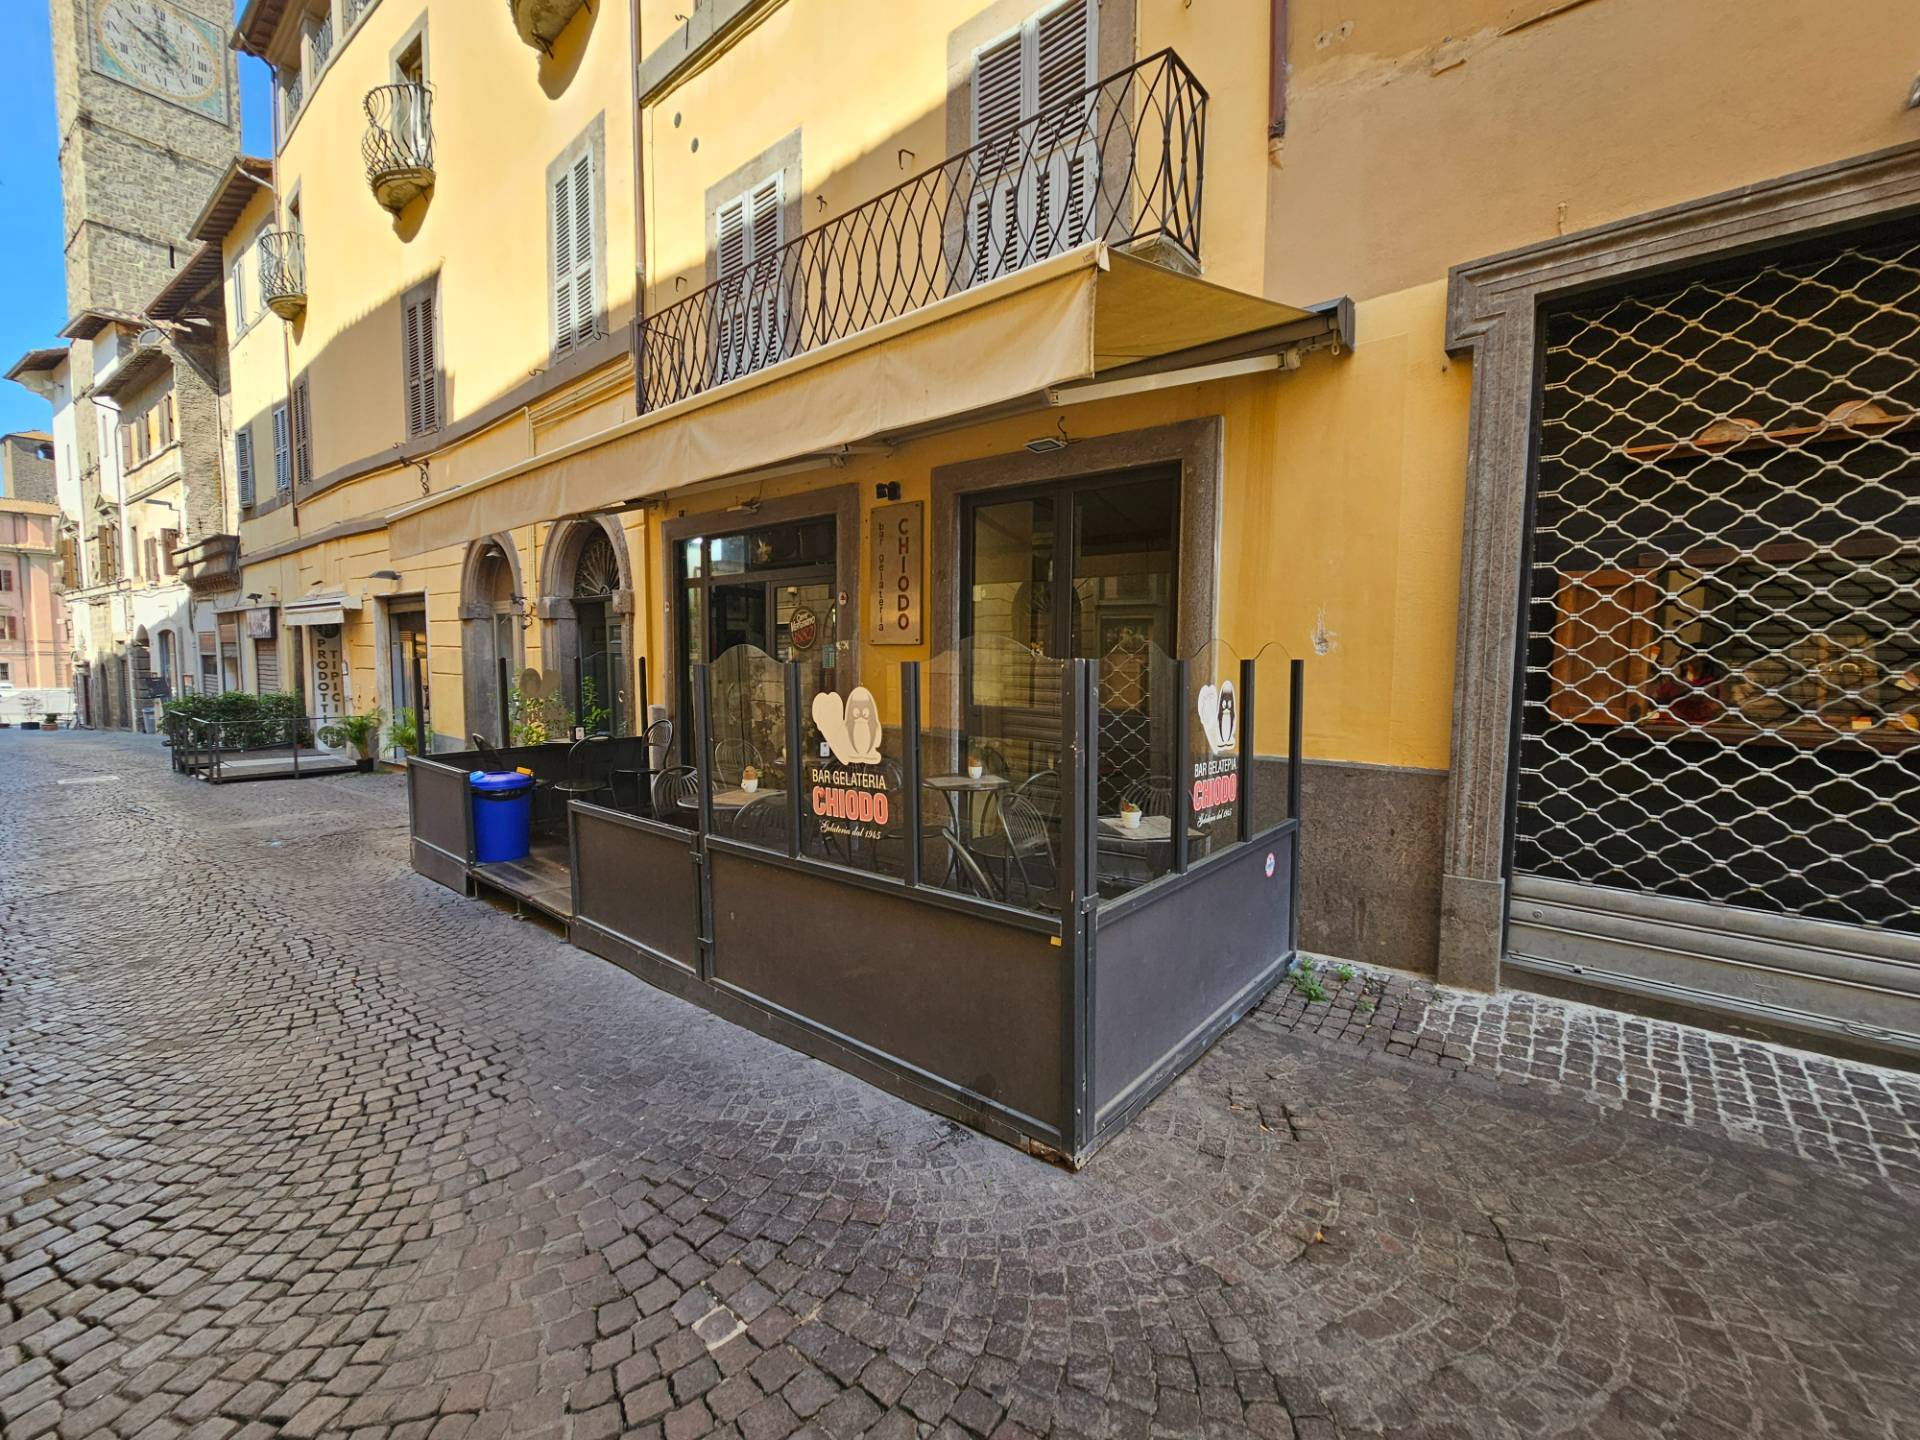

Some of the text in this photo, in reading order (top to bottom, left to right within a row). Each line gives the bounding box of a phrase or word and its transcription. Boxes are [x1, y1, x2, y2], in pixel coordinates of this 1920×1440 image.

[897, 518, 910, 630] CHIODO
[317, 639, 330, 724] PRODOTTI
[329, 649, 341, 713] TIPICI
[812, 768, 887, 789] BAR GELATERIA
[1194, 762, 1208, 778] BAR
[812, 785, 889, 825] CHIODO
[1193, 773, 1237, 812] CHIODO
